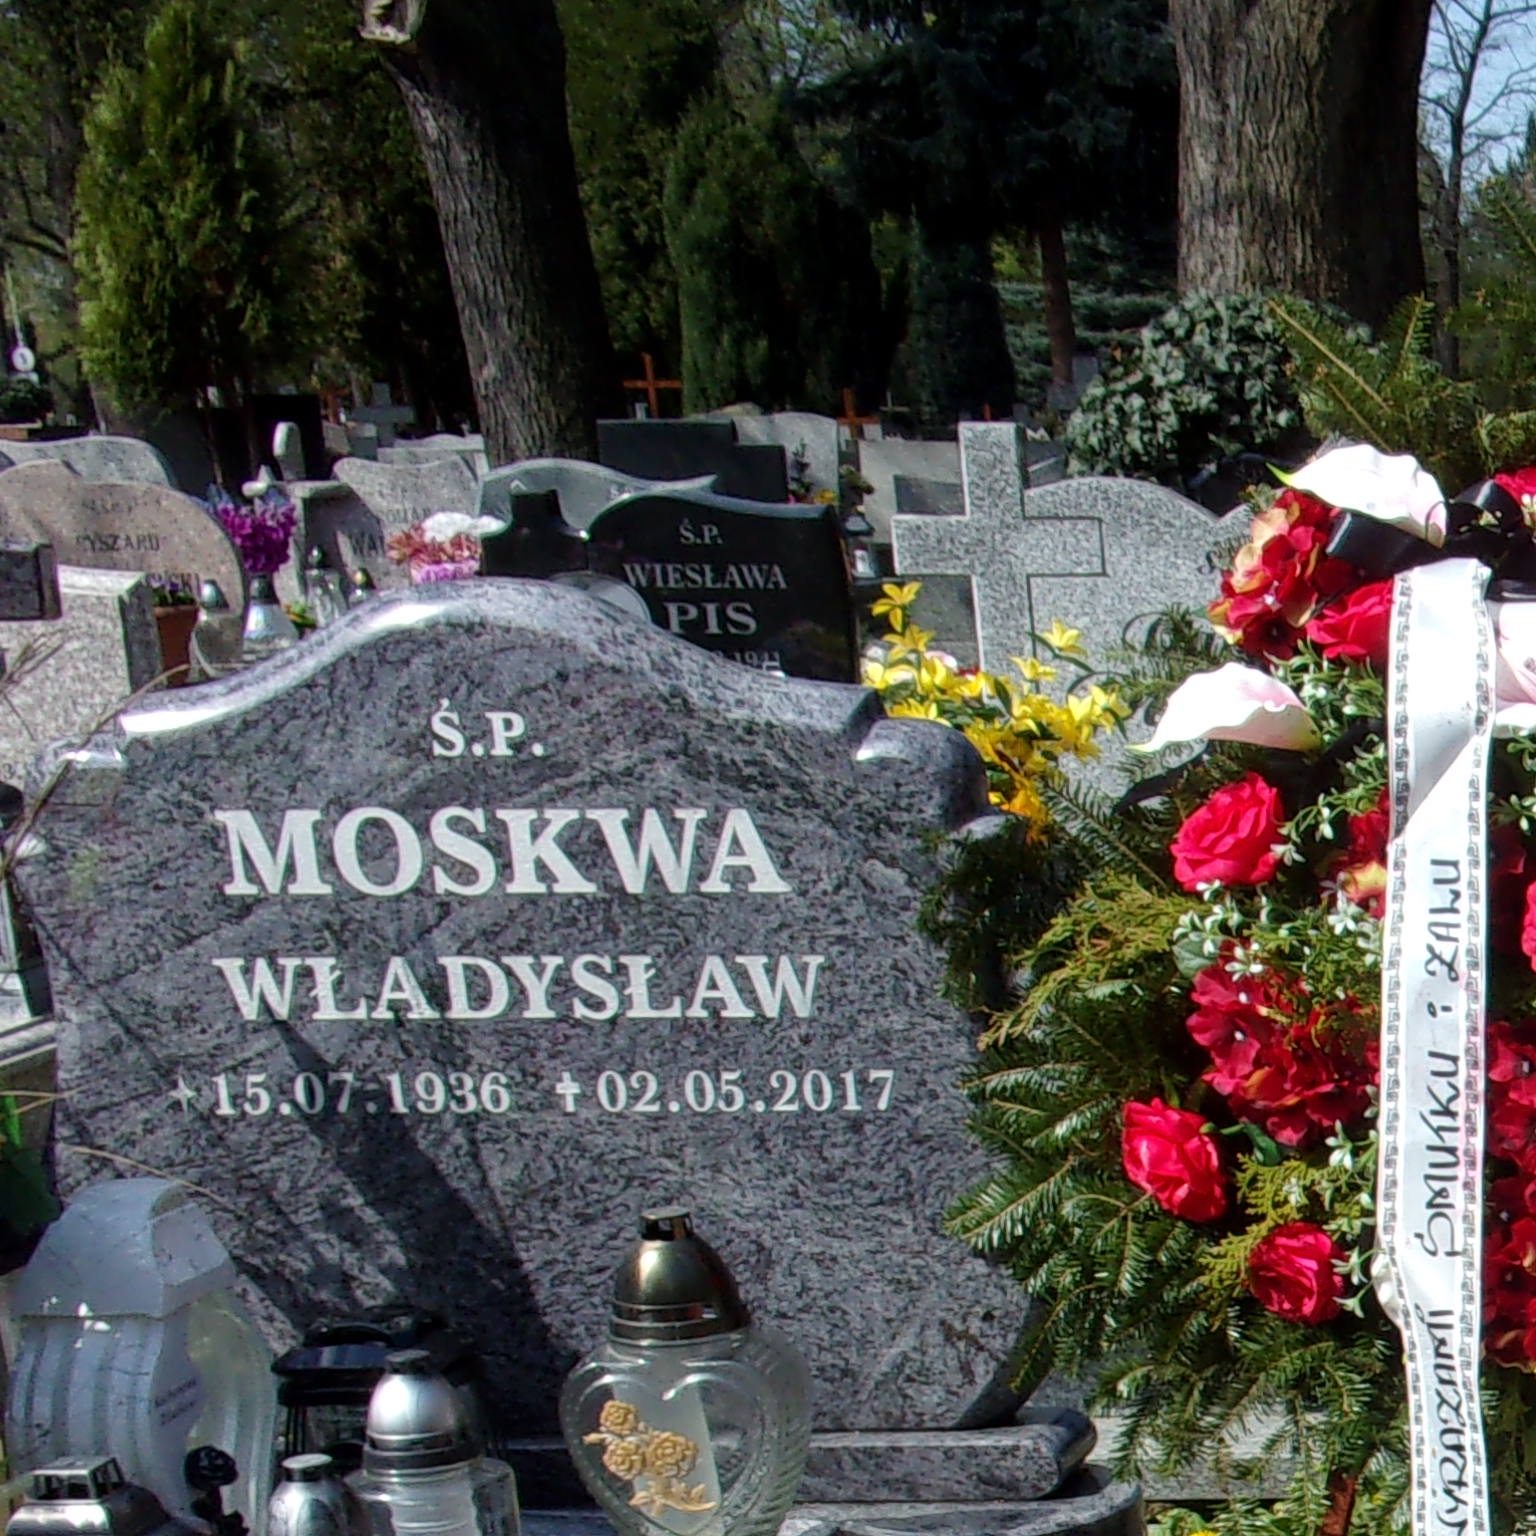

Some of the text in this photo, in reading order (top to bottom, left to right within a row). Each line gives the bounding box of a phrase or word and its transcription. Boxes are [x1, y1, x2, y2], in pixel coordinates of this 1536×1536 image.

[623, 563, 788, 590] WIESŁAWA
[662, 601, 758, 636] PIS
[429, 700, 547, 760] Ś.P.
[213, 806, 794, 898] MOSKWA
[211, 954, 826, 1023] WŁADYSŁAW
[213, 1069, 896, 1117] 15.07.1936 02.05.2017
